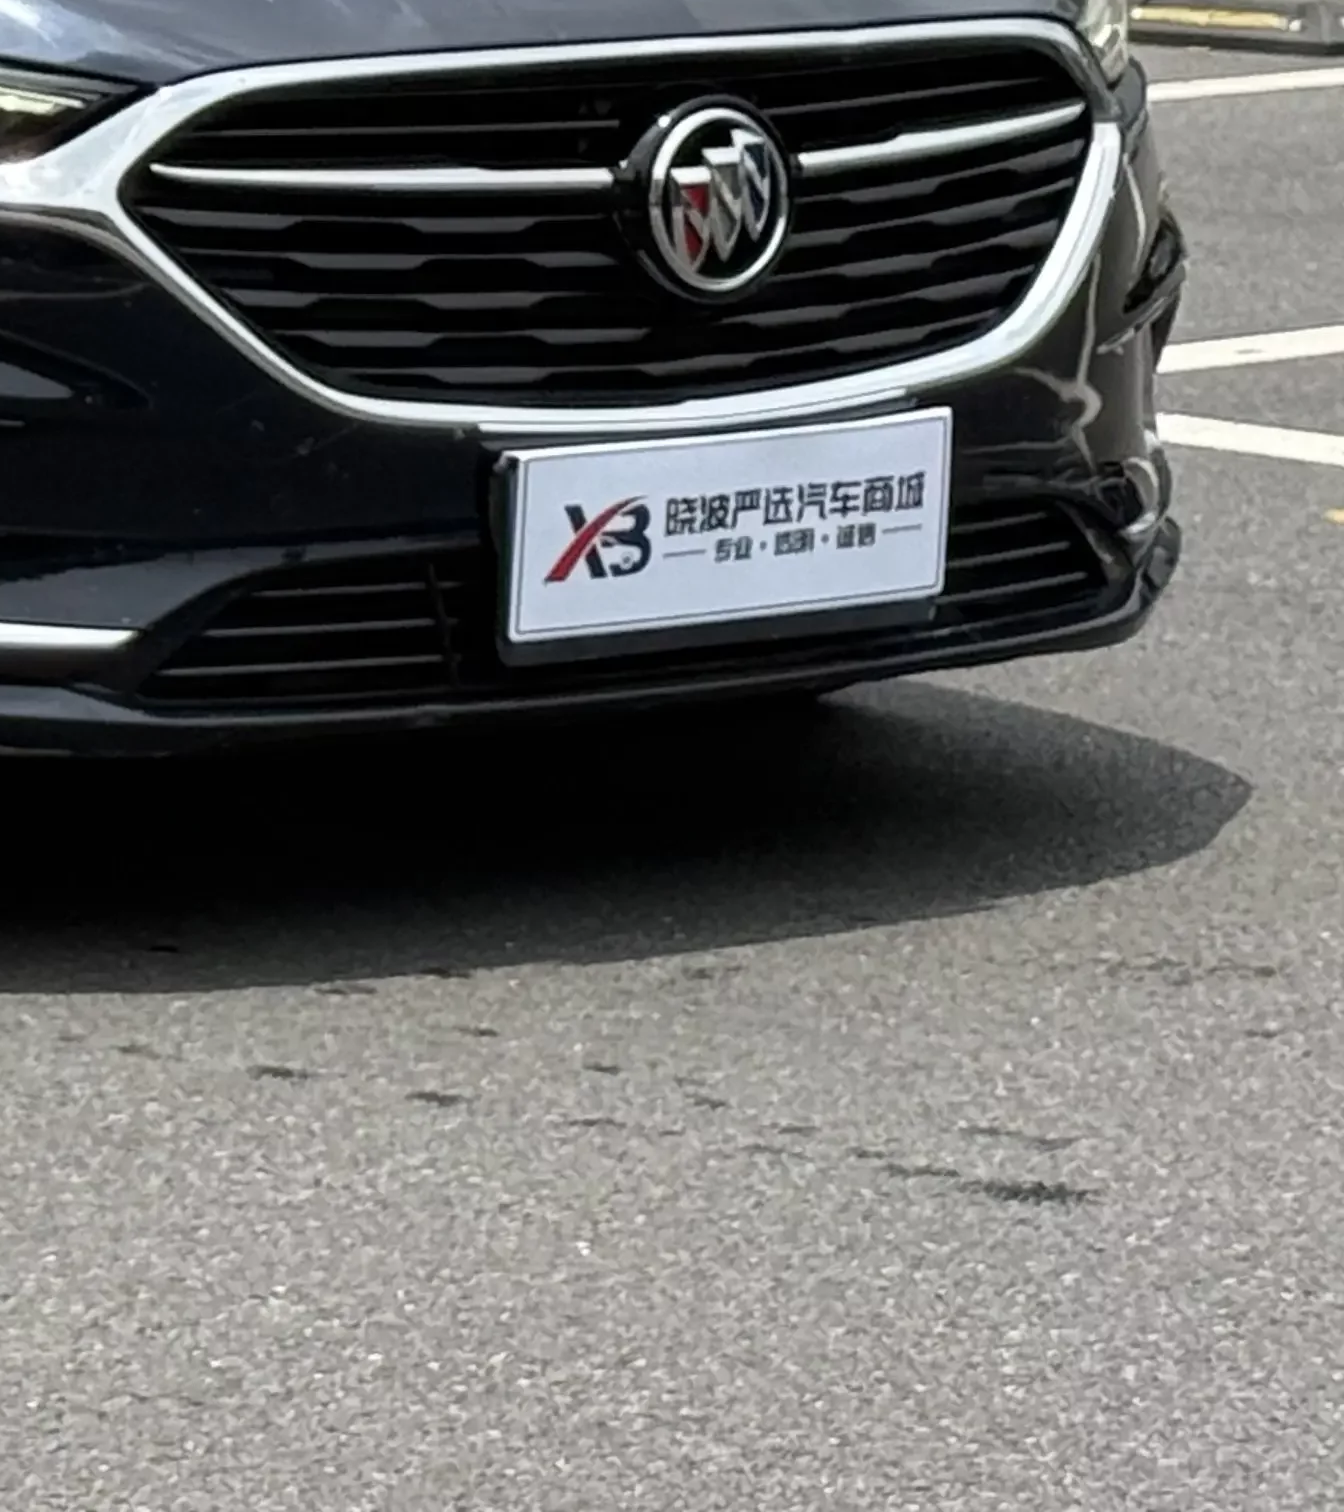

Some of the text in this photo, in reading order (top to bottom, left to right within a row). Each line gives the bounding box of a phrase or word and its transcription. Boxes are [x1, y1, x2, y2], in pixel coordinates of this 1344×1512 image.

[664, 471, 926, 537] 晓波严选汽车商城
